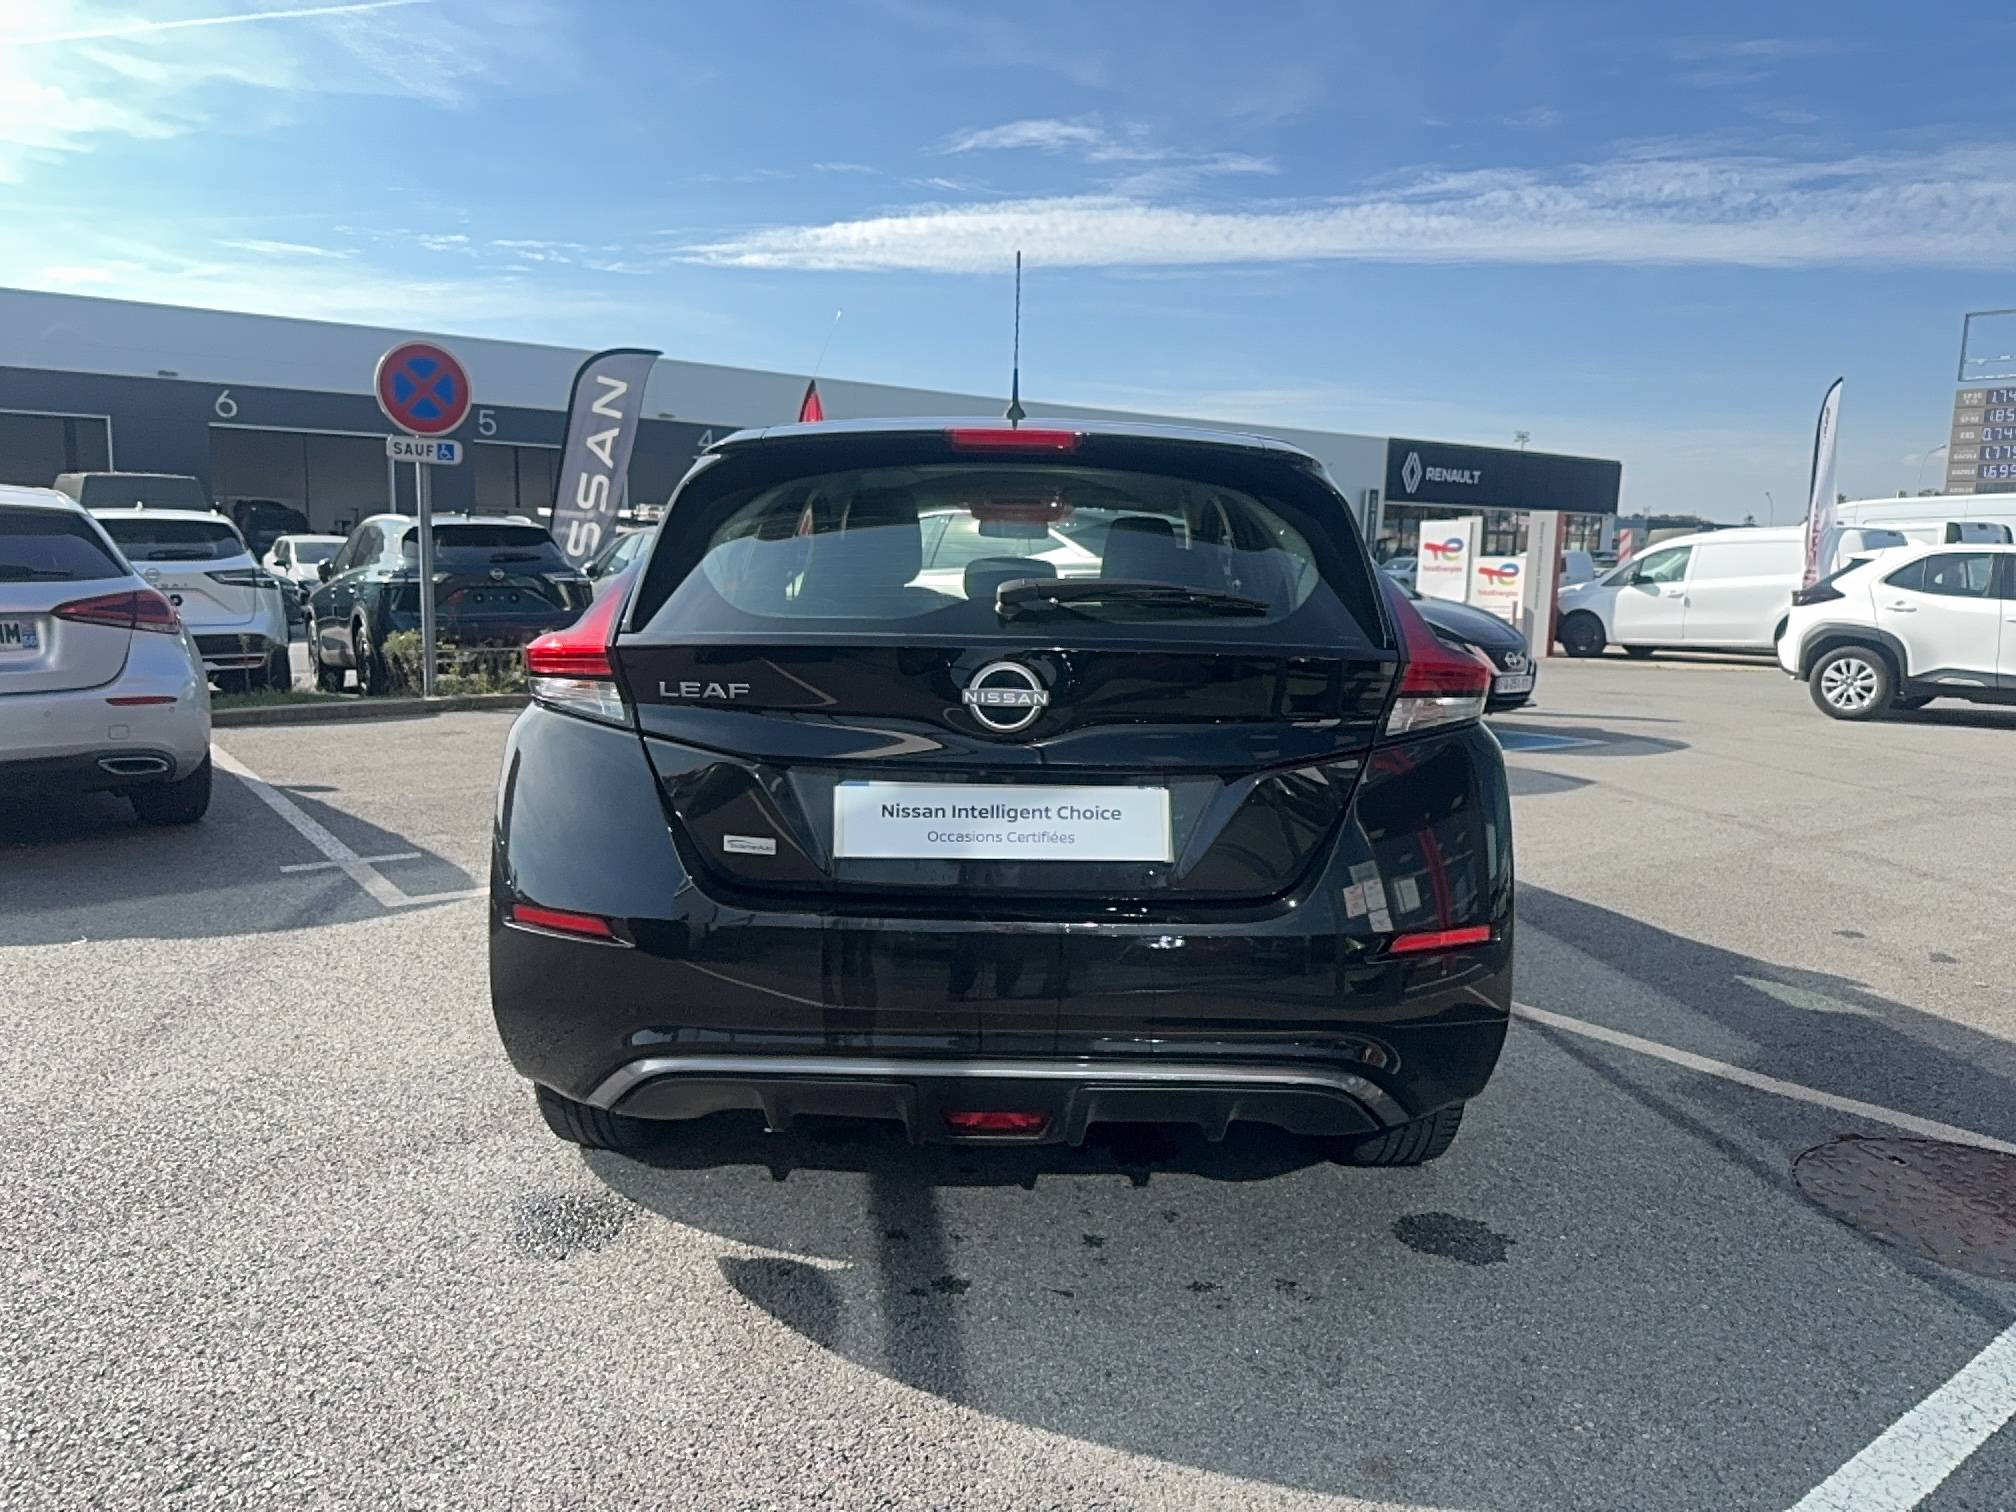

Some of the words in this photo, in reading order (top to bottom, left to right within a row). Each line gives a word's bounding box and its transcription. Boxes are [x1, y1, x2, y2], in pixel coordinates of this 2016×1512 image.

[215, 390, 237, 418] 6
[478, 410, 497, 435] 5
[393, 442, 434, 457] SAUF
[1425, 467, 1481, 484] RENAULT
[659, 681, 751, 700] LEAF
[964, 691, 1049, 705] NISSAN
[881, 803, 946, 819] Nissan
[951, 804, 1052, 822] Intelligent
[1057, 805, 1122, 820] Choice
[927, 830, 1002, 843] Occasions
[1007, 831, 1075, 844] Certifiées
